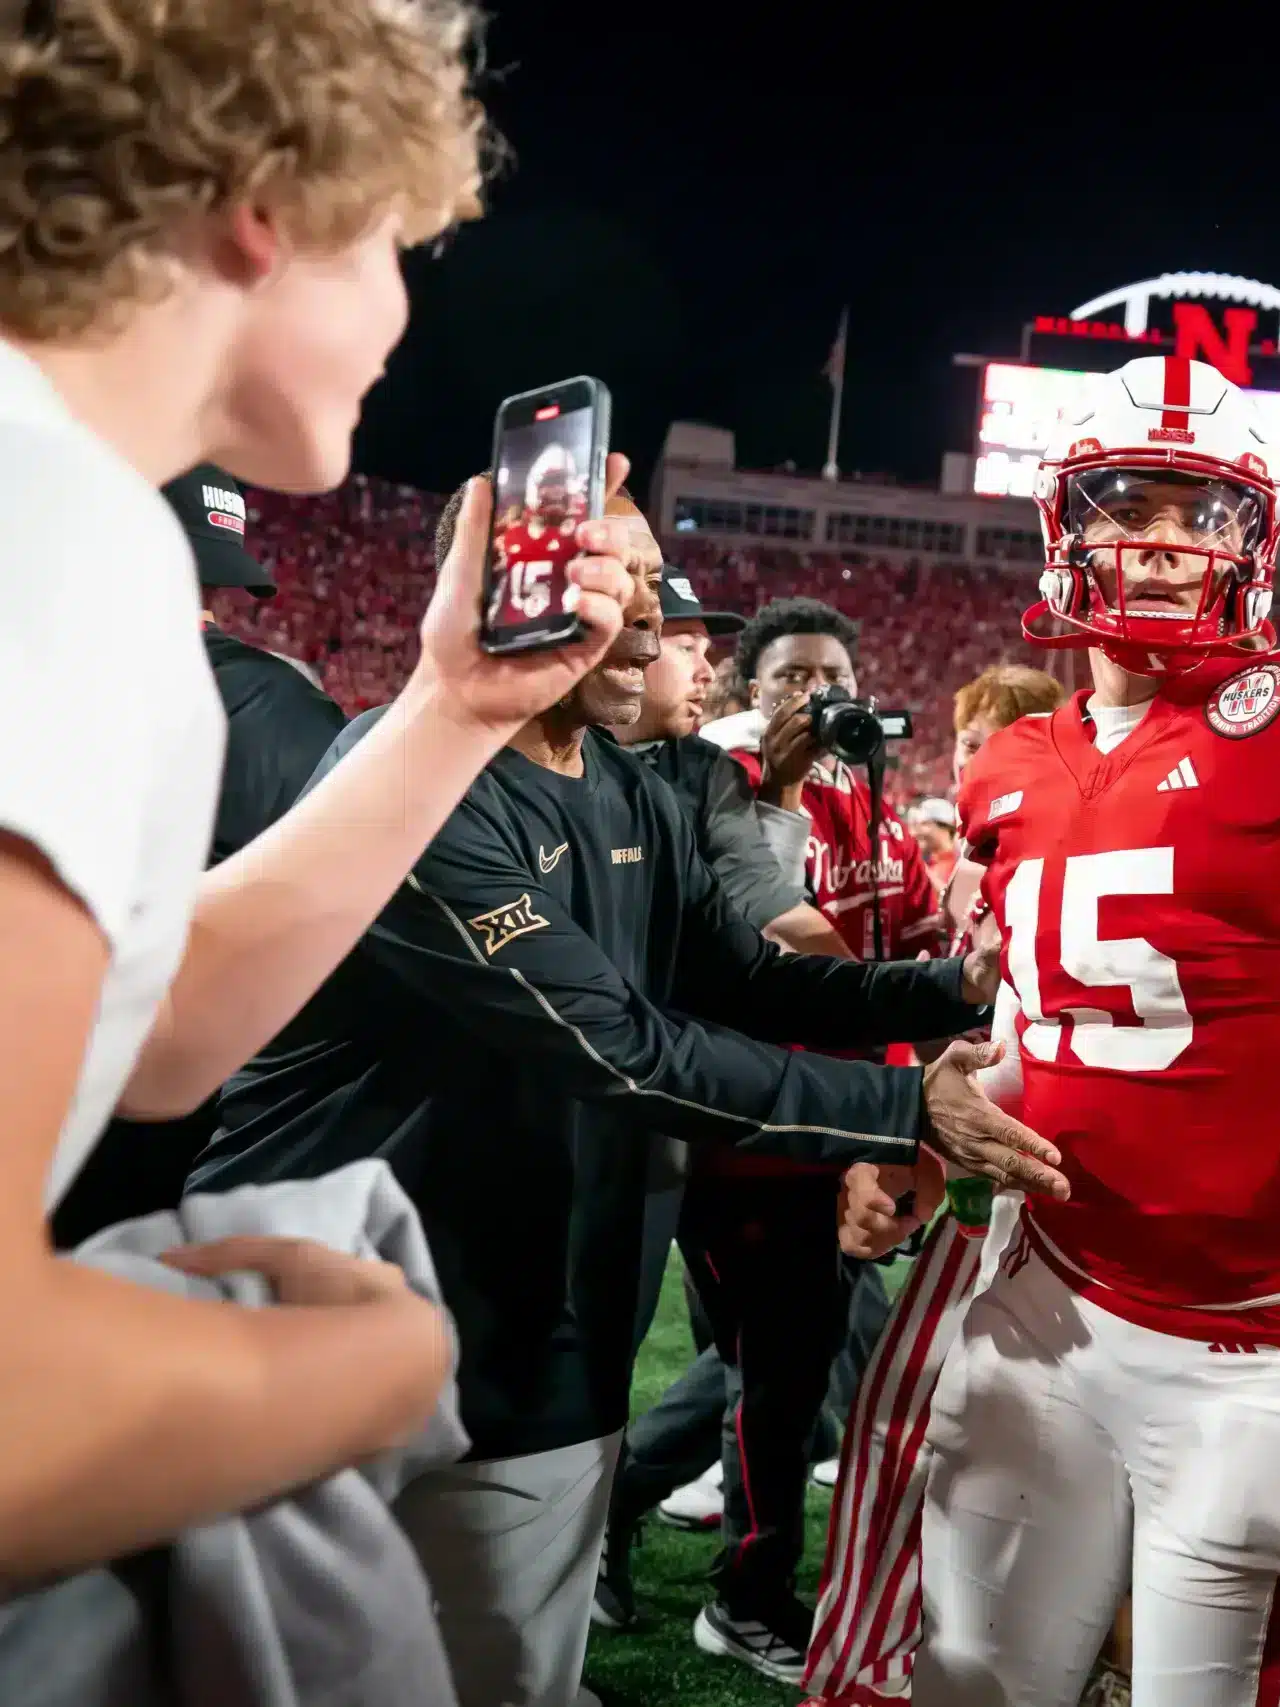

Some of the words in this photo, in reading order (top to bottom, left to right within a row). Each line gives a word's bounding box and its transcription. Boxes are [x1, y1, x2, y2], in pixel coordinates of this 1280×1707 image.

[1034, 315, 1162, 345] MEMORL
[1172, 302, 1257, 387] N
[1223, 687, 1270, 703] HUSKERS
[1242, 695, 1280, 732] TRADITION
[1005, 846, 1194, 1072] 15
